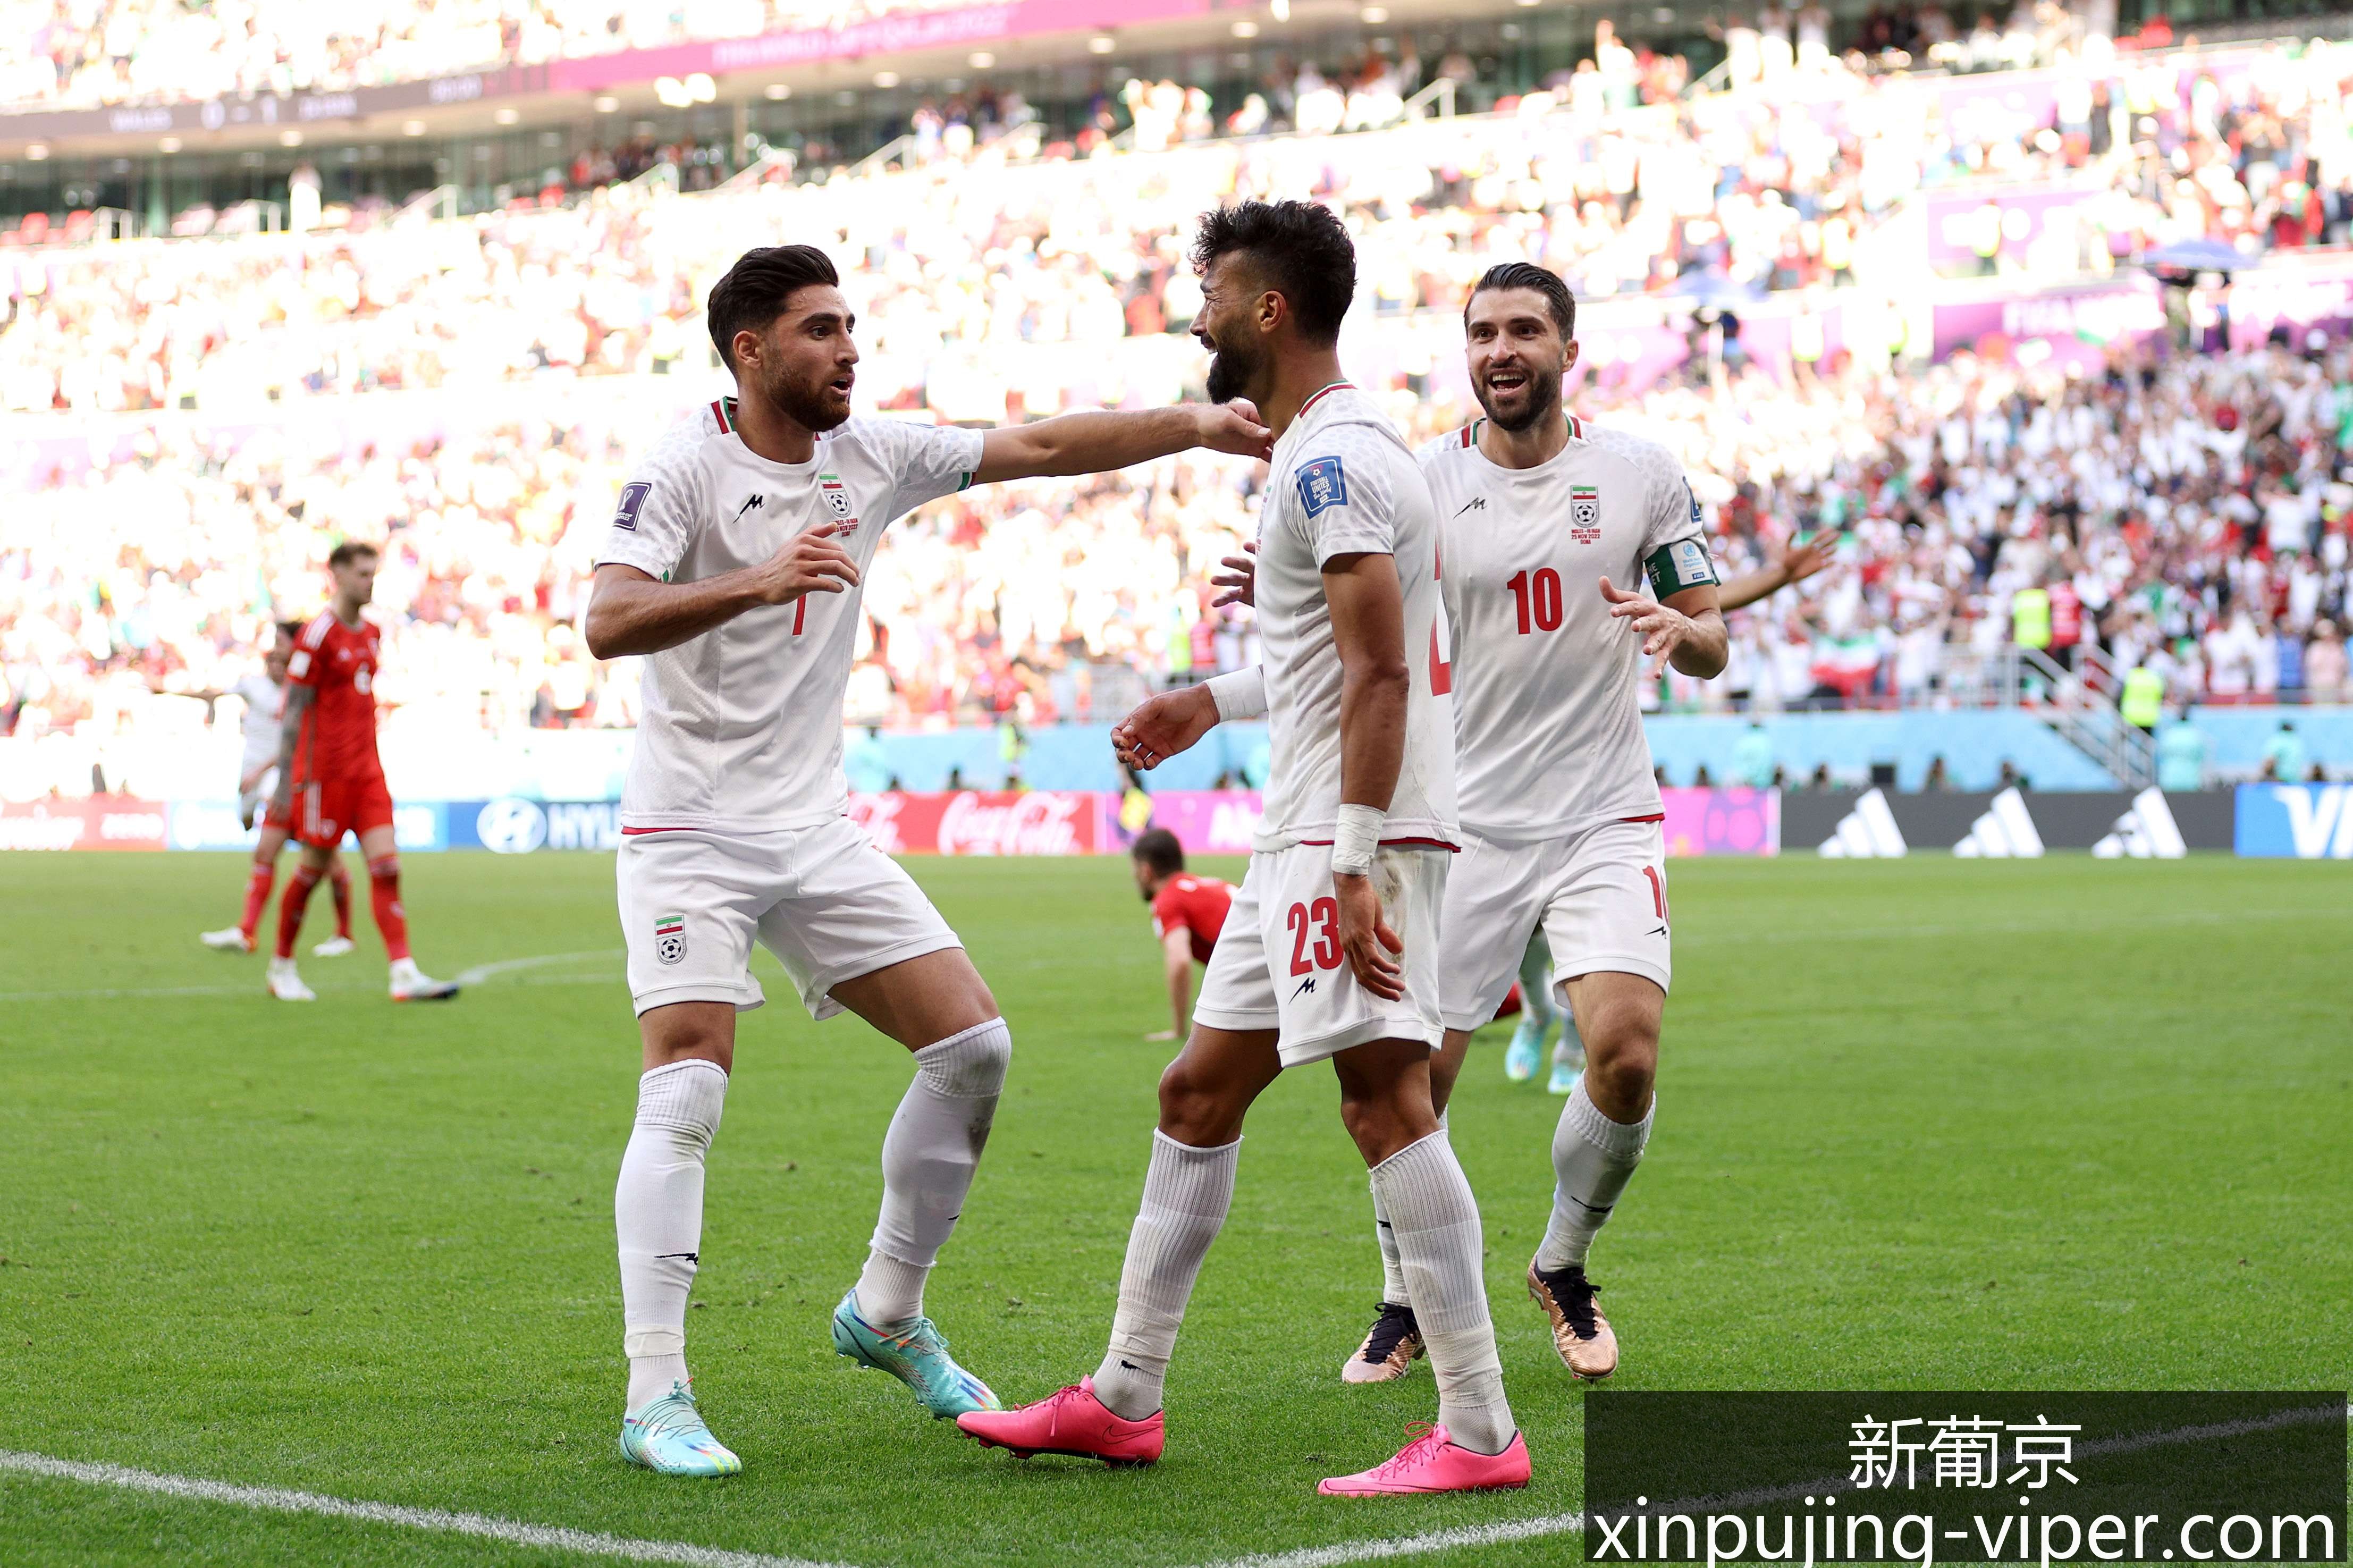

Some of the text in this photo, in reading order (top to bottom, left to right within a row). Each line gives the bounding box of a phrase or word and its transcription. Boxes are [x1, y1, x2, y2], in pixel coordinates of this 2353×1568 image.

[1312, 480, 1329, 493] UNITES
[1507, 568, 1563, 635] 10
[1287, 896, 1344, 977] 23
